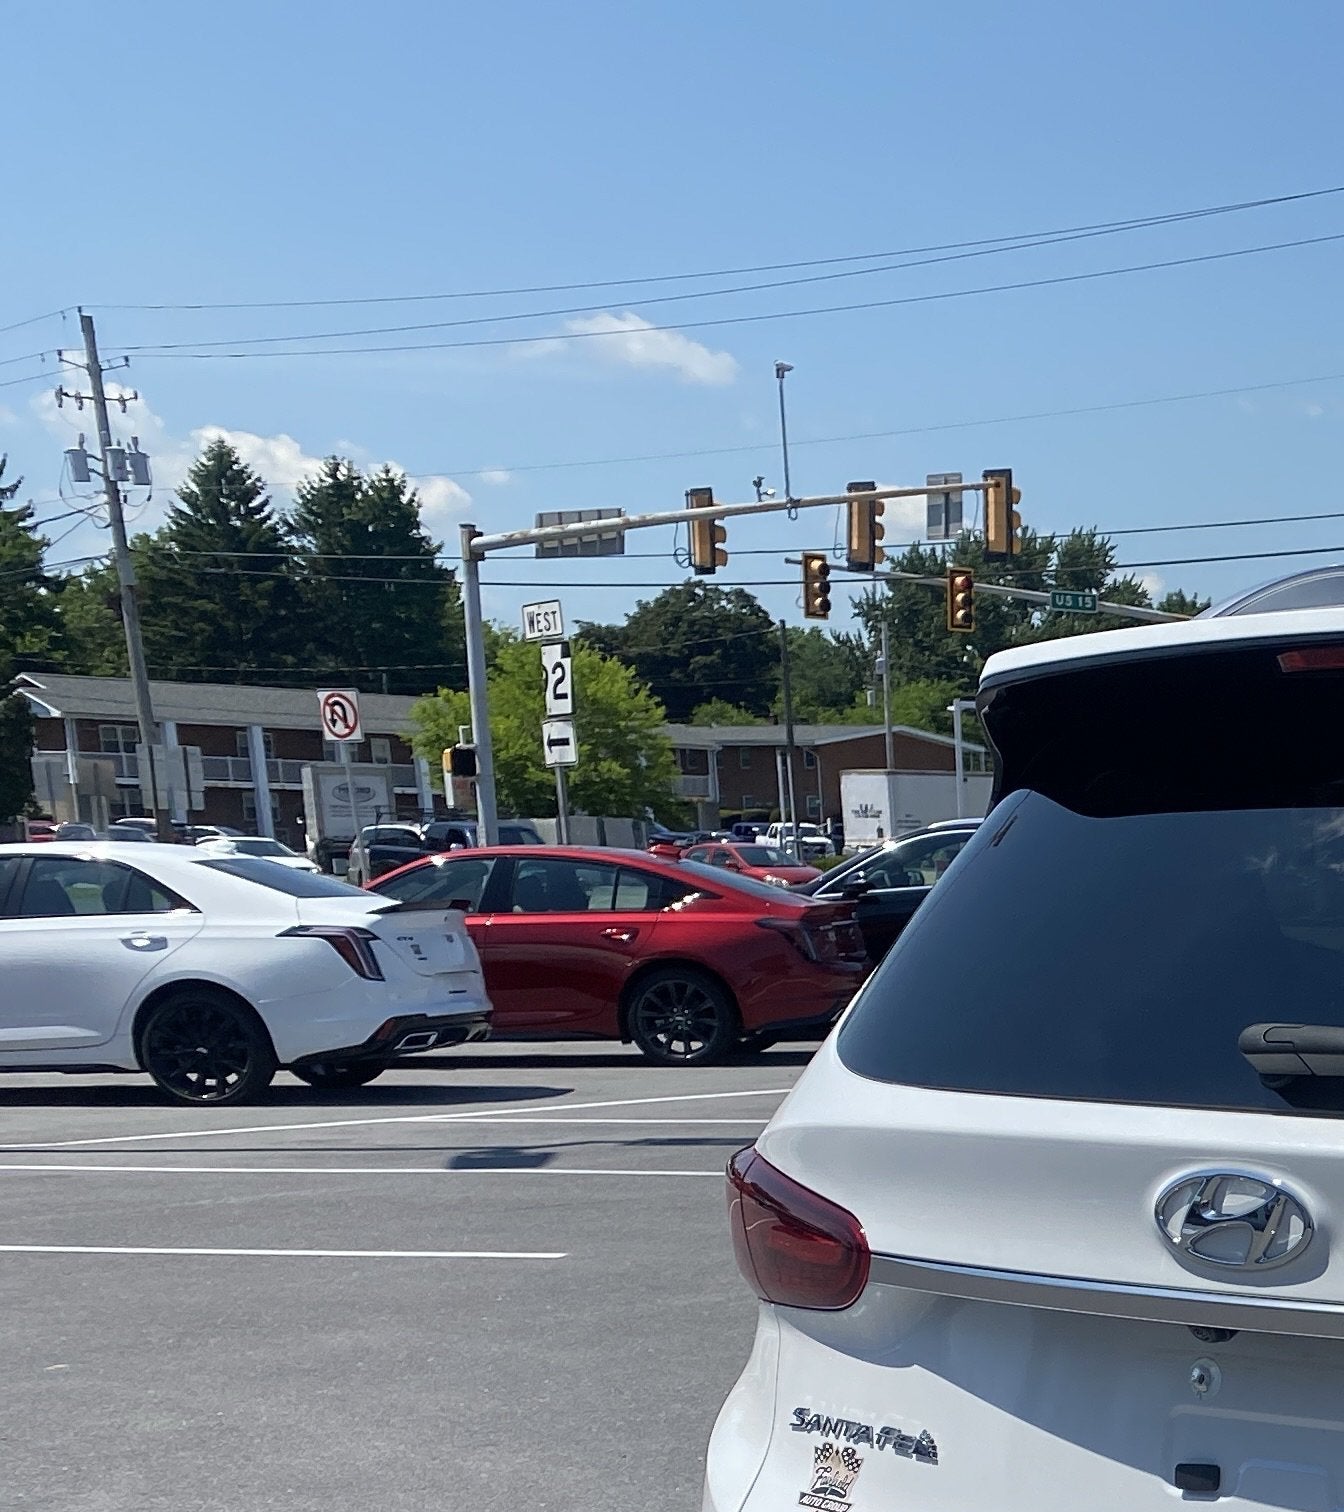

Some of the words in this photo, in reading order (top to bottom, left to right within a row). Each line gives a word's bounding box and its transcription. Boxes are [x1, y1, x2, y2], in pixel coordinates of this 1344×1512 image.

[1055, 594, 1073, 607] US
[1078, 596, 1093, 608] 15
[526, 610, 558, 634] WEST
[800, 1494, 823, 1507] AUTO
[820, 1500, 849, 1512] GROUP
